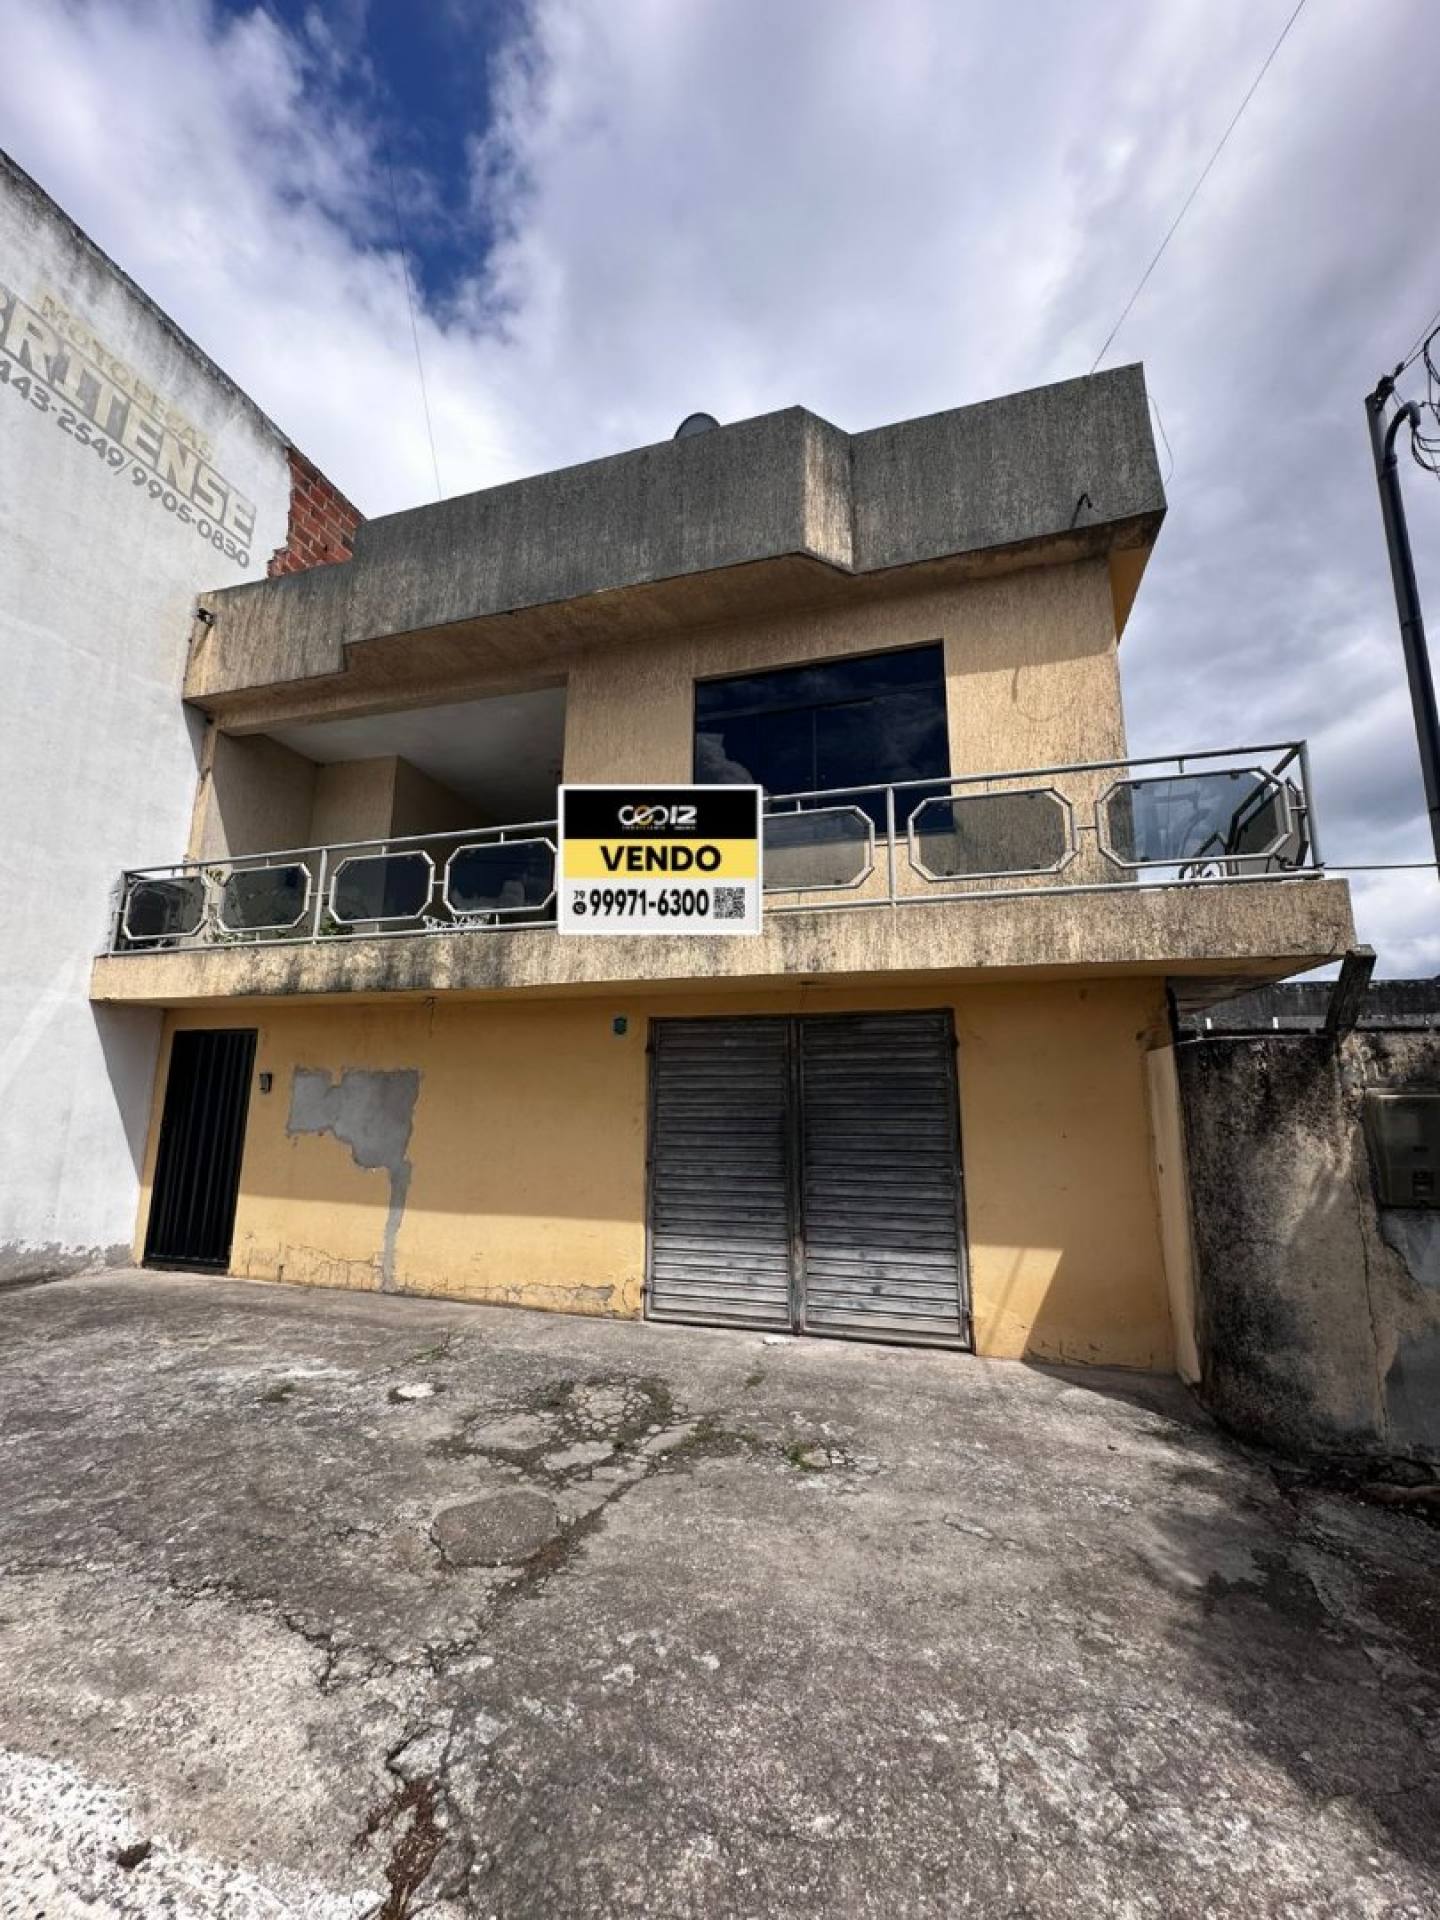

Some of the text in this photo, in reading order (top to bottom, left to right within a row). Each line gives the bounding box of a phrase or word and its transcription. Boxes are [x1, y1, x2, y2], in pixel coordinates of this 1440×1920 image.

[0, 286, 256, 549] RITENSE
[600, 845, 722, 872] VENDO
[589, 888, 709, 916] 99971-6300
